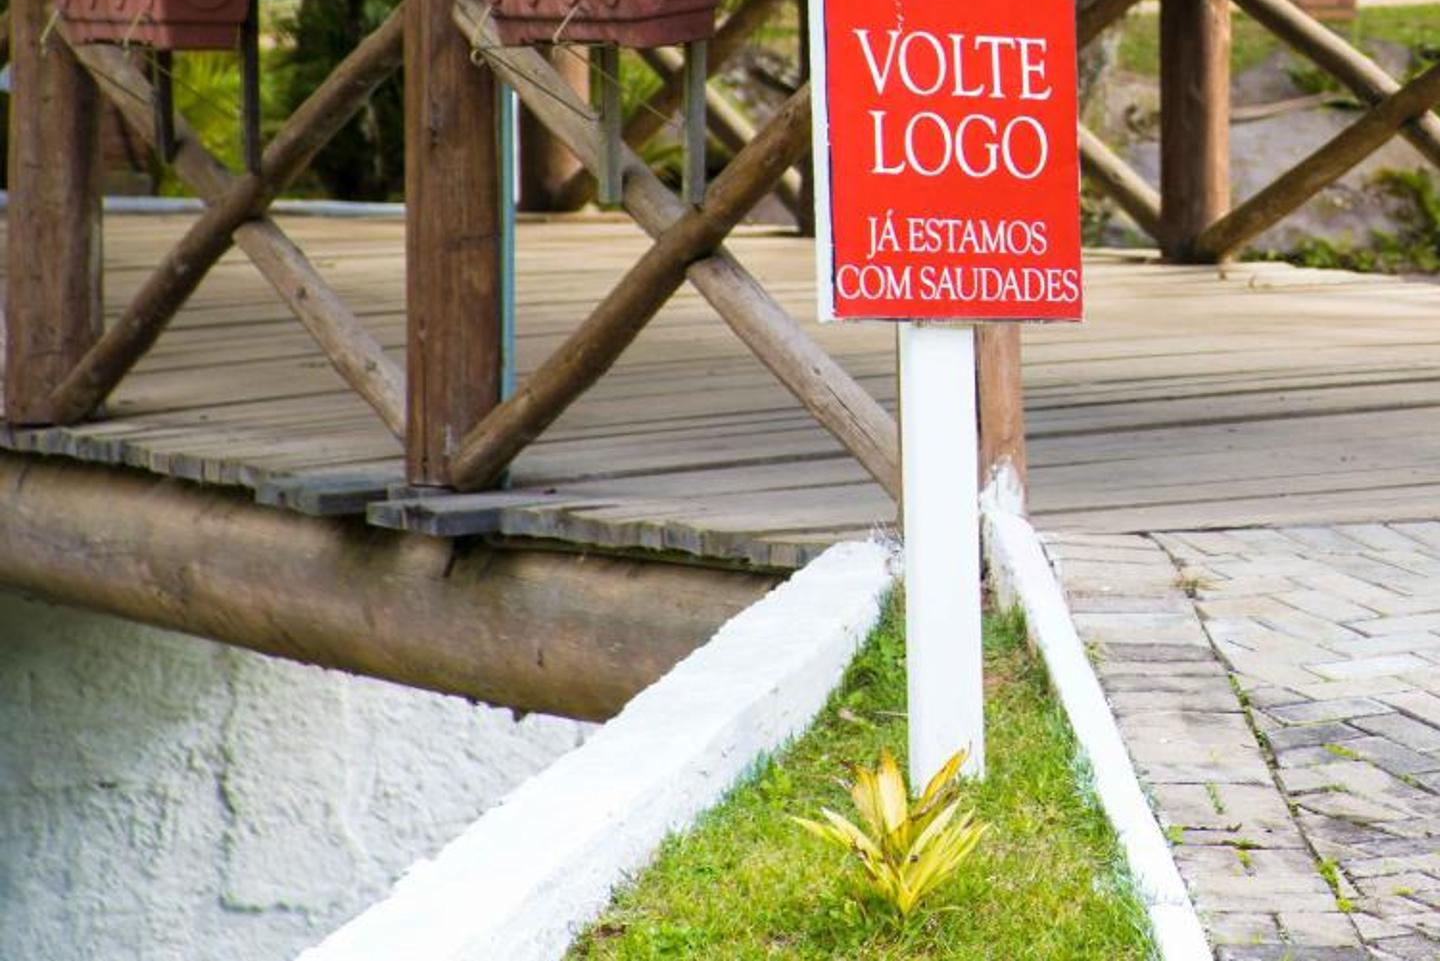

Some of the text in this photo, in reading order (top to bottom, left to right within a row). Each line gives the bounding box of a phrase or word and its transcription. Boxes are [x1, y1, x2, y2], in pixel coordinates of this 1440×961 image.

[853, 28, 1052, 100] VOLTE
[869, 110, 1048, 179] LOGO
[867, 210, 1047, 259] JÁ ESTAMOS
[836, 265, 1079, 302] COM SAUDADES
